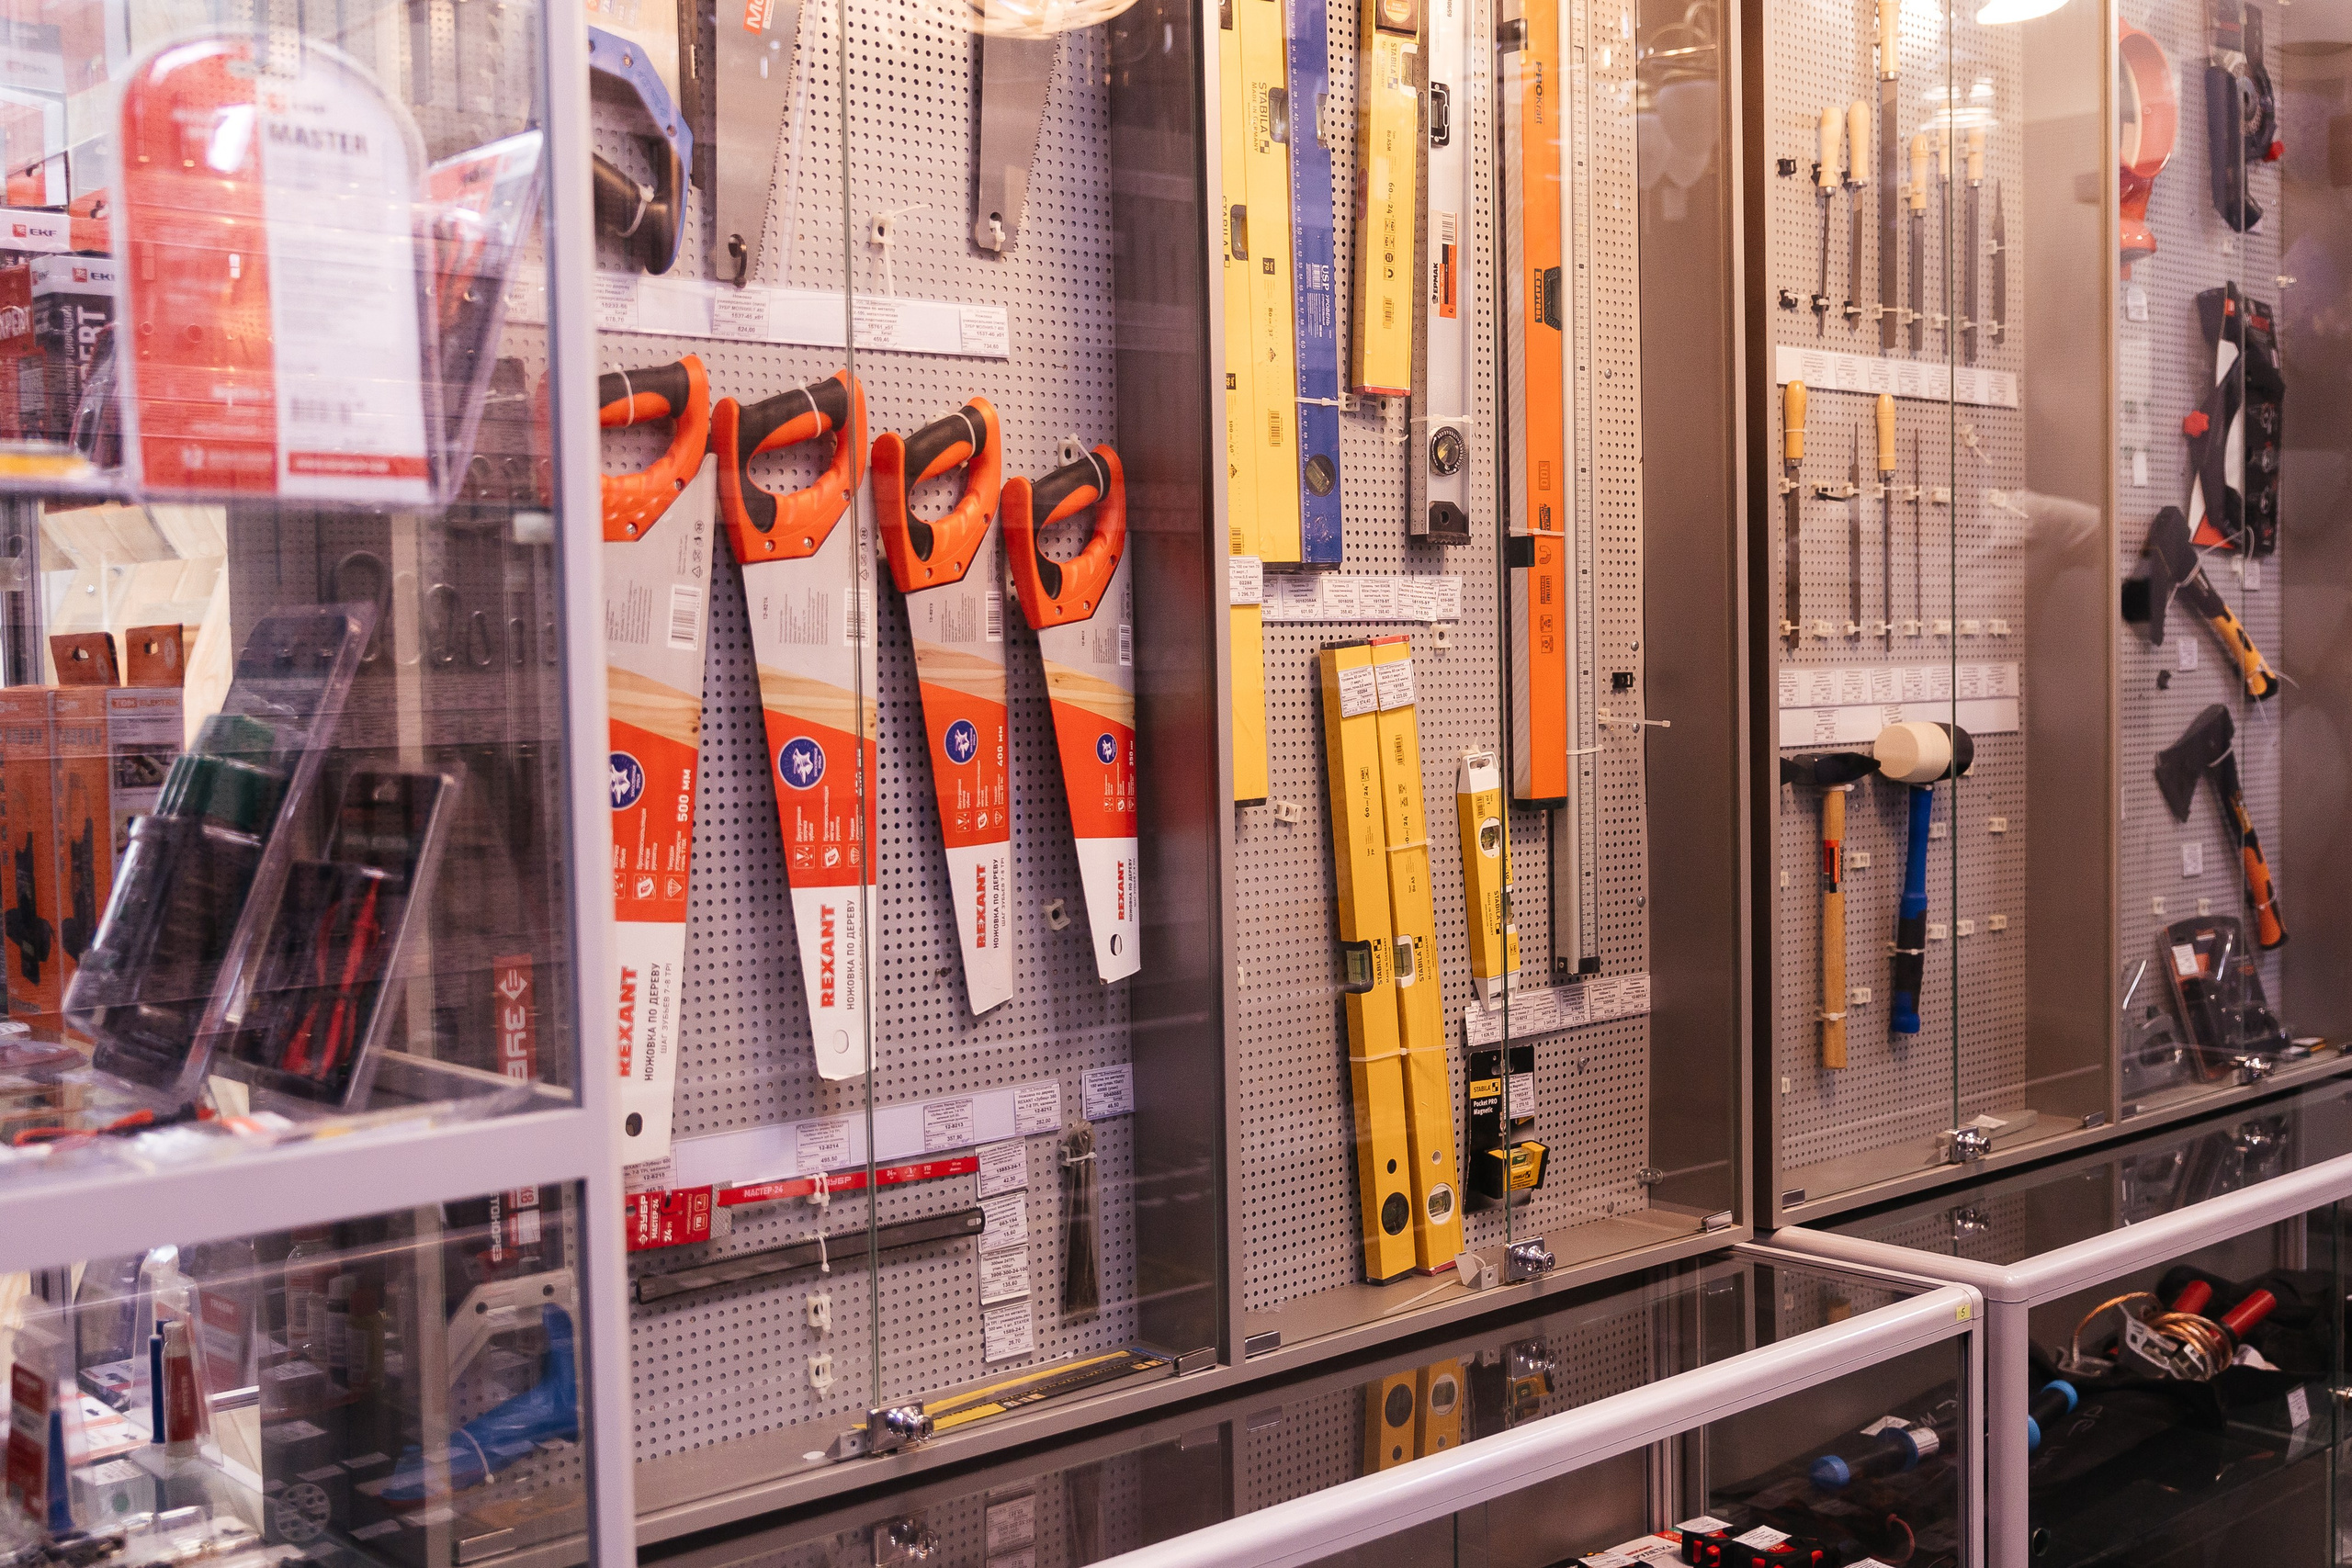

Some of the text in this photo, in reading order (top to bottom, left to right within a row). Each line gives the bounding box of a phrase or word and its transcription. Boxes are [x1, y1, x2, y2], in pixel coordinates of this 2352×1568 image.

[1259, 82, 1268, 133] STABILA
[29, 228, 57, 237] EKF
[678, 794, 690, 822] 500
[1365, 805, 1371, 818] 60
[976, 863, 986, 949] REXANT
[993, 893, 999, 905] ПО
[820, 904, 835, 1009] REXANT
[846, 899, 856, 1010] НОЖОВКА ПО ДЕРЕВУ
[663, 978, 672, 995] 7-8
[619, 966, 638, 1077] REXANT
[645, 963, 661, 1081] НОЖОВКА ПО ДЕРЕВУ
[662, 996, 670, 1032] ЗУБЬЕВ
[1473, 1084, 1491, 1093] STABILA
[1473, 1097, 1498, 1108] Pocket PRO
[1473, 1107, 1493, 1116] Magnetic
[743, 1185, 784, 1198] МАСТЕР-24
[639, 1195, 649, 1233] ЗУБР
[651, 1198, 660, 1239] МАСТЕР-24
[664, 1228, 673, 1243] 24
